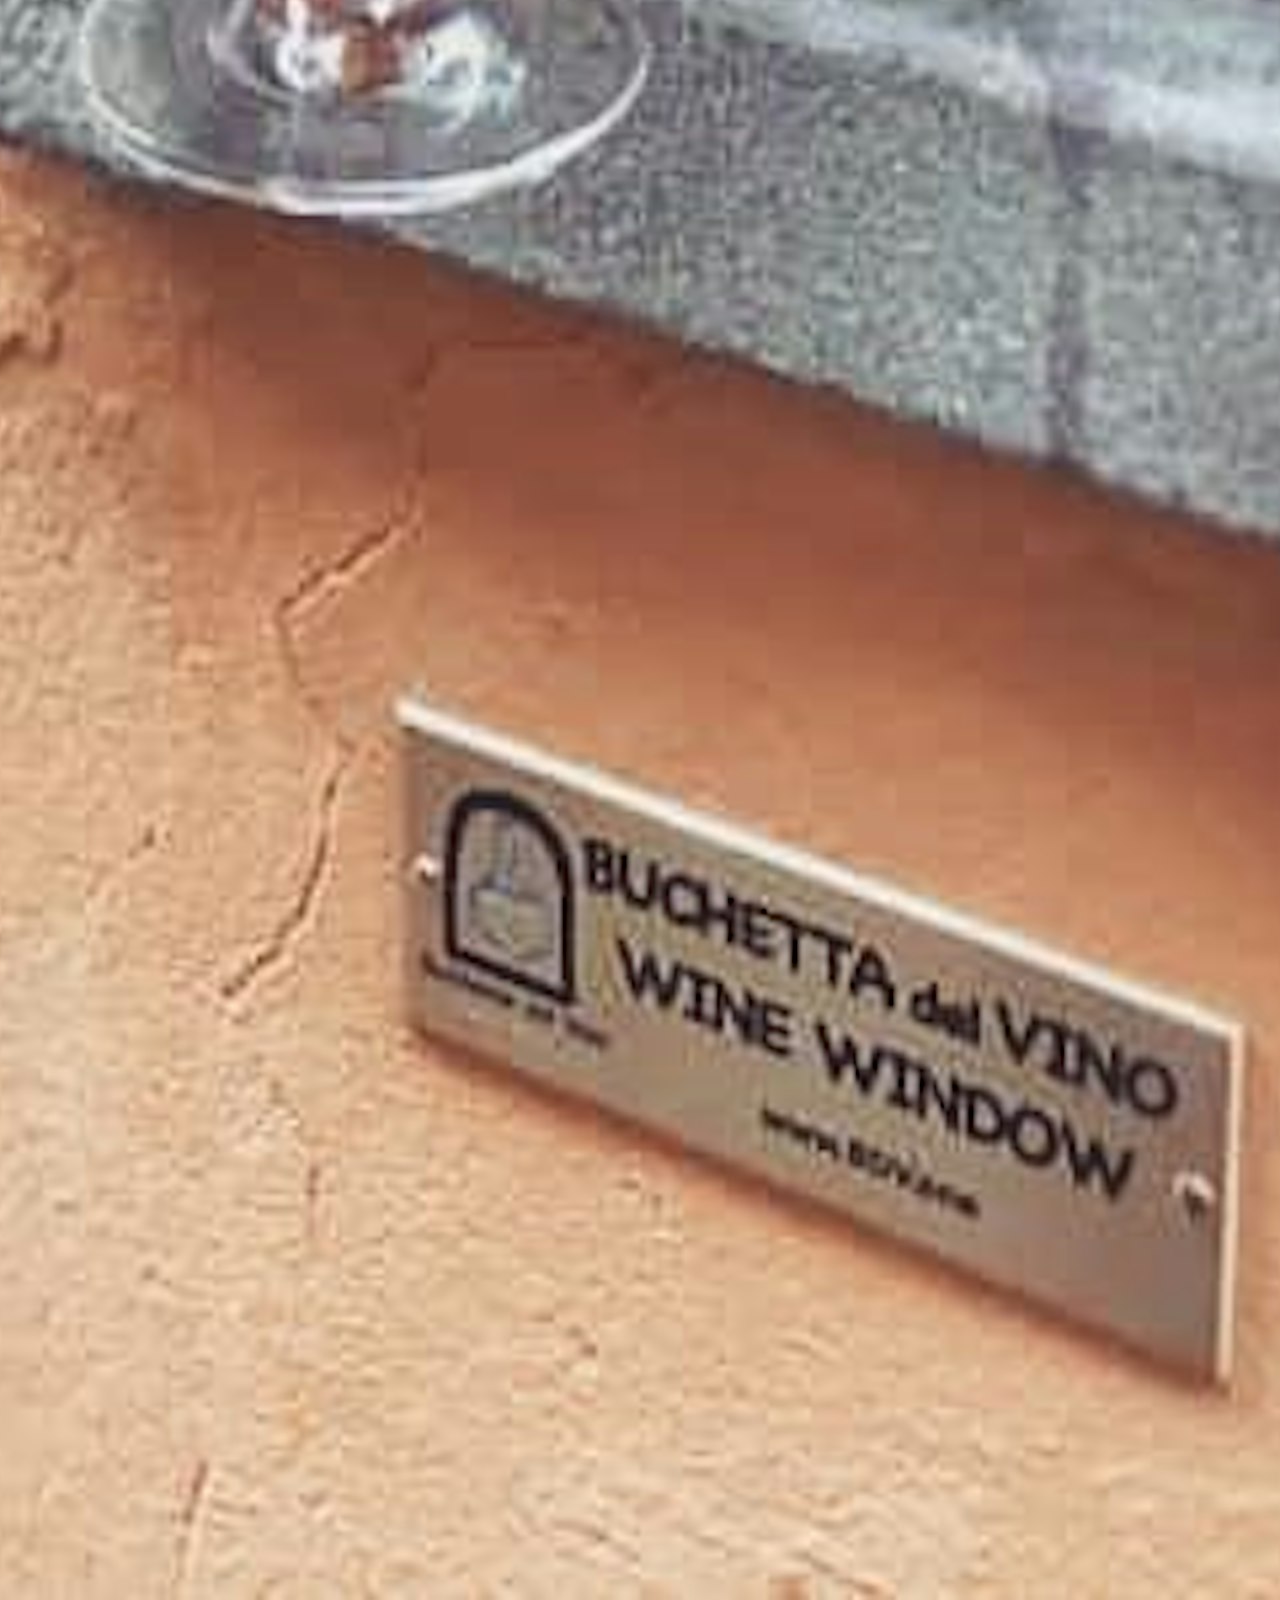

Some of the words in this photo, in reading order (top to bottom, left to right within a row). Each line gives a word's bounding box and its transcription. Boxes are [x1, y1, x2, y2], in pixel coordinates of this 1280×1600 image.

[582, 838, 896, 1008] BUCHETTA
[912, 984, 981, 1045] del
[998, 1002, 1180, 1120] VINO
[619, 938, 792, 1056] WINE
[815, 1022, 1134, 1203] WINDOW
